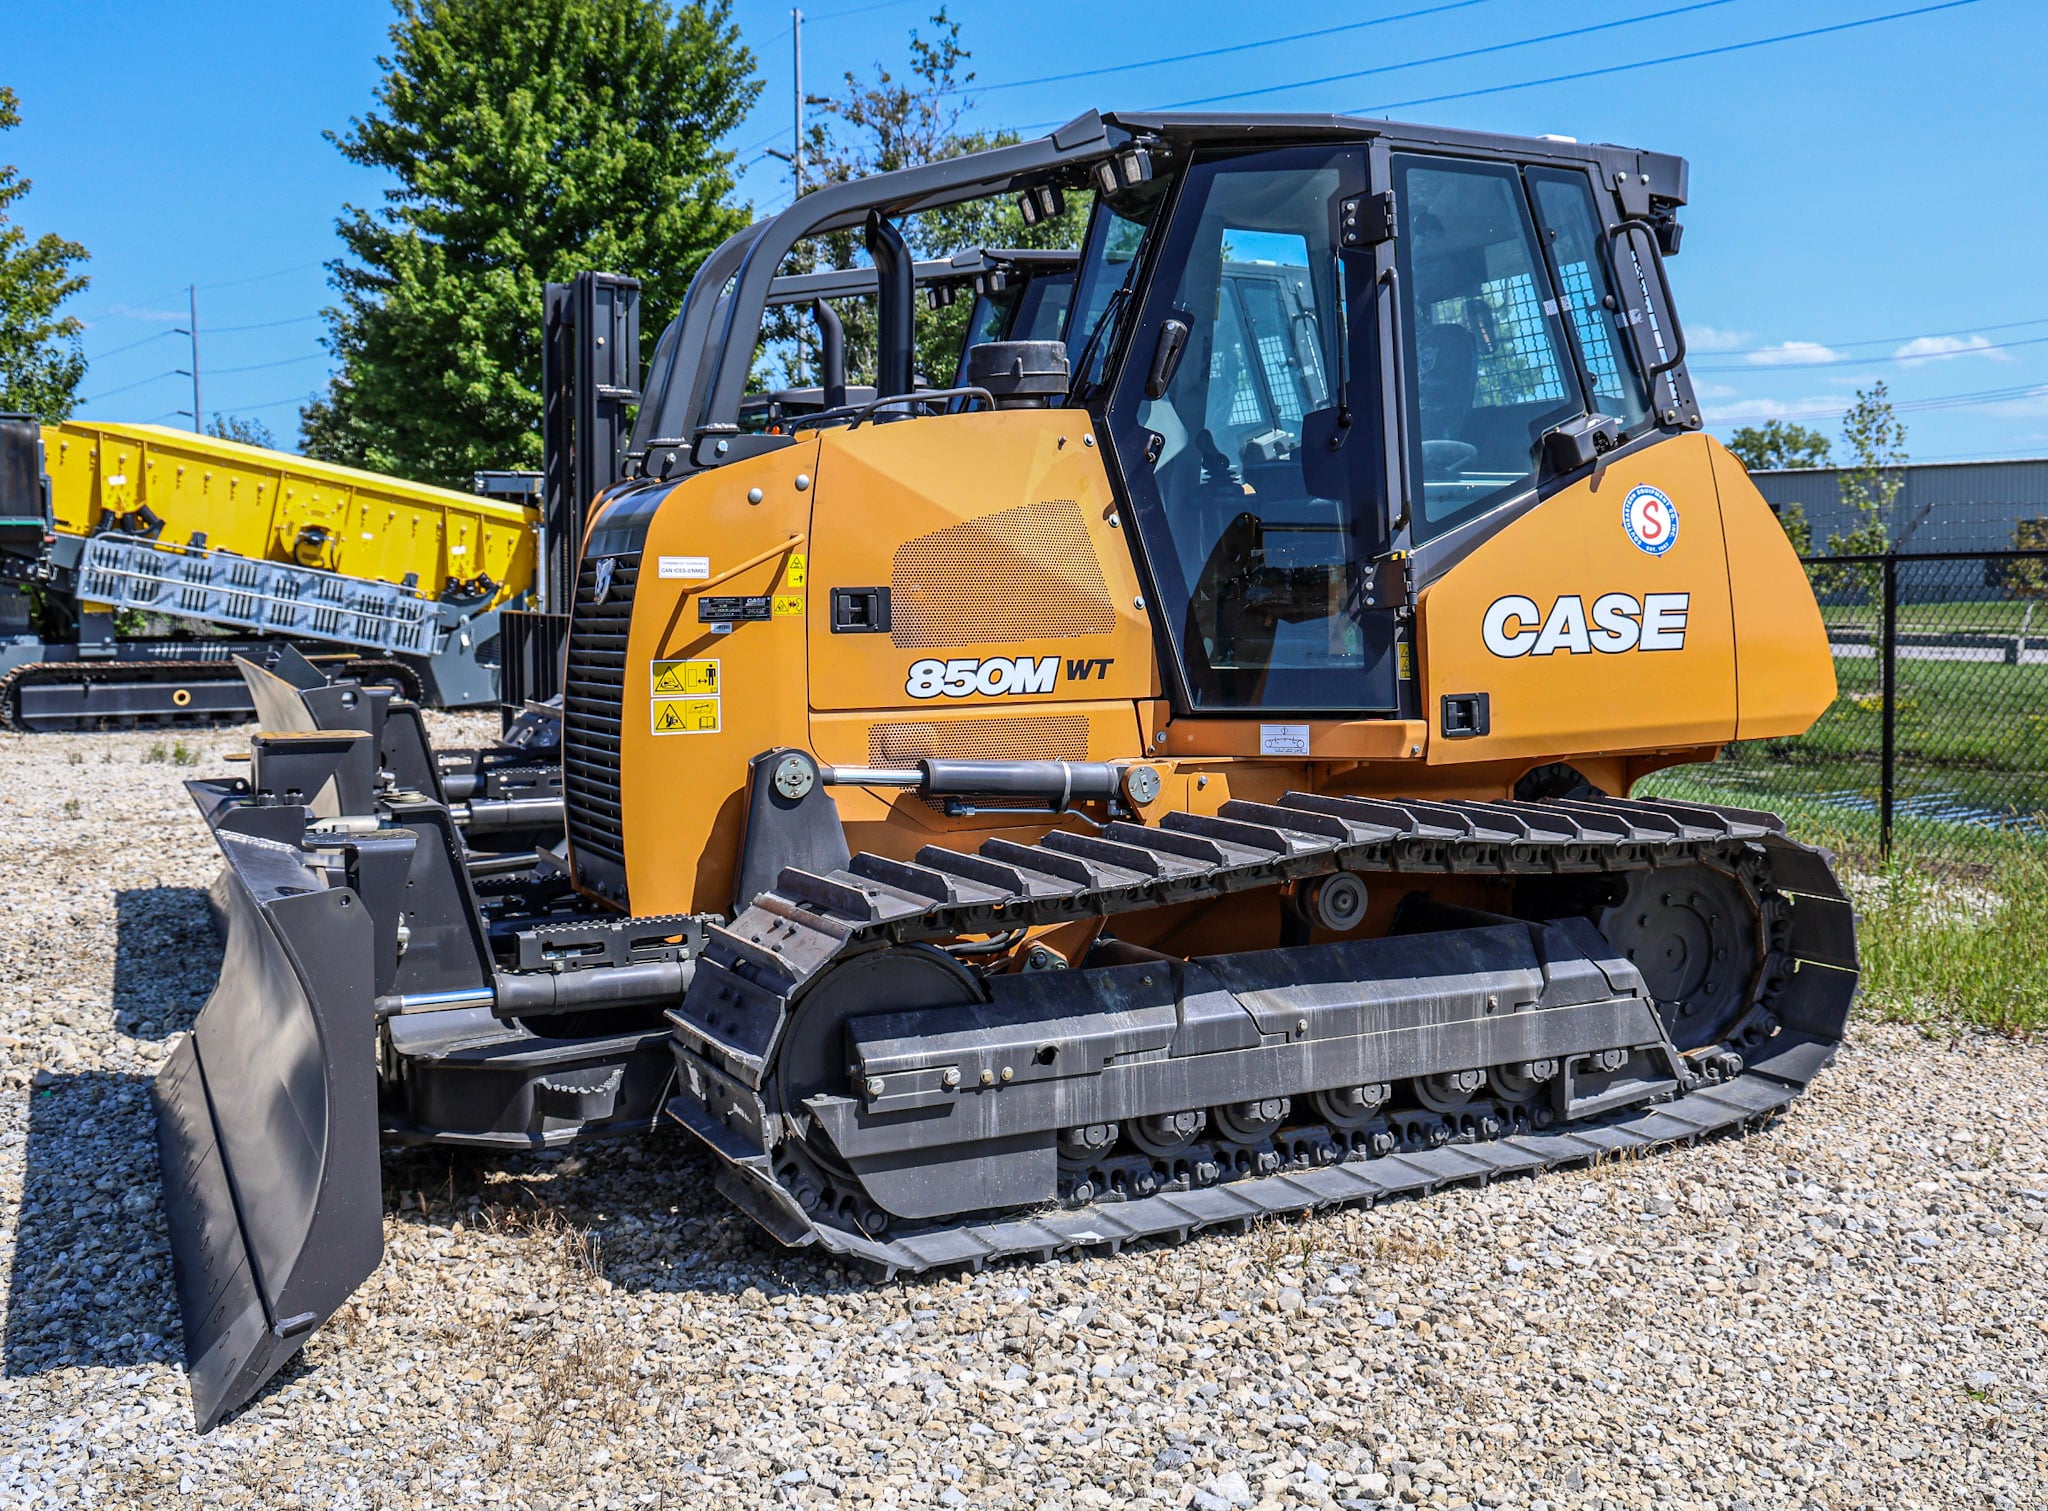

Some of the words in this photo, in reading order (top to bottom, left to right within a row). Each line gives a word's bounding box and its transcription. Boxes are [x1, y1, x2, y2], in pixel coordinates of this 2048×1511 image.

[1624, 492, 1643, 546] SOUTHEASTERN
[1636, 487, 1670, 507] EQUIPMENT
[1642, 500, 1662, 540] S
[1481, 592, 1691, 659] CASE
[904, 655, 1062, 699] 850M
[1065, 658, 1115, 681] WT
